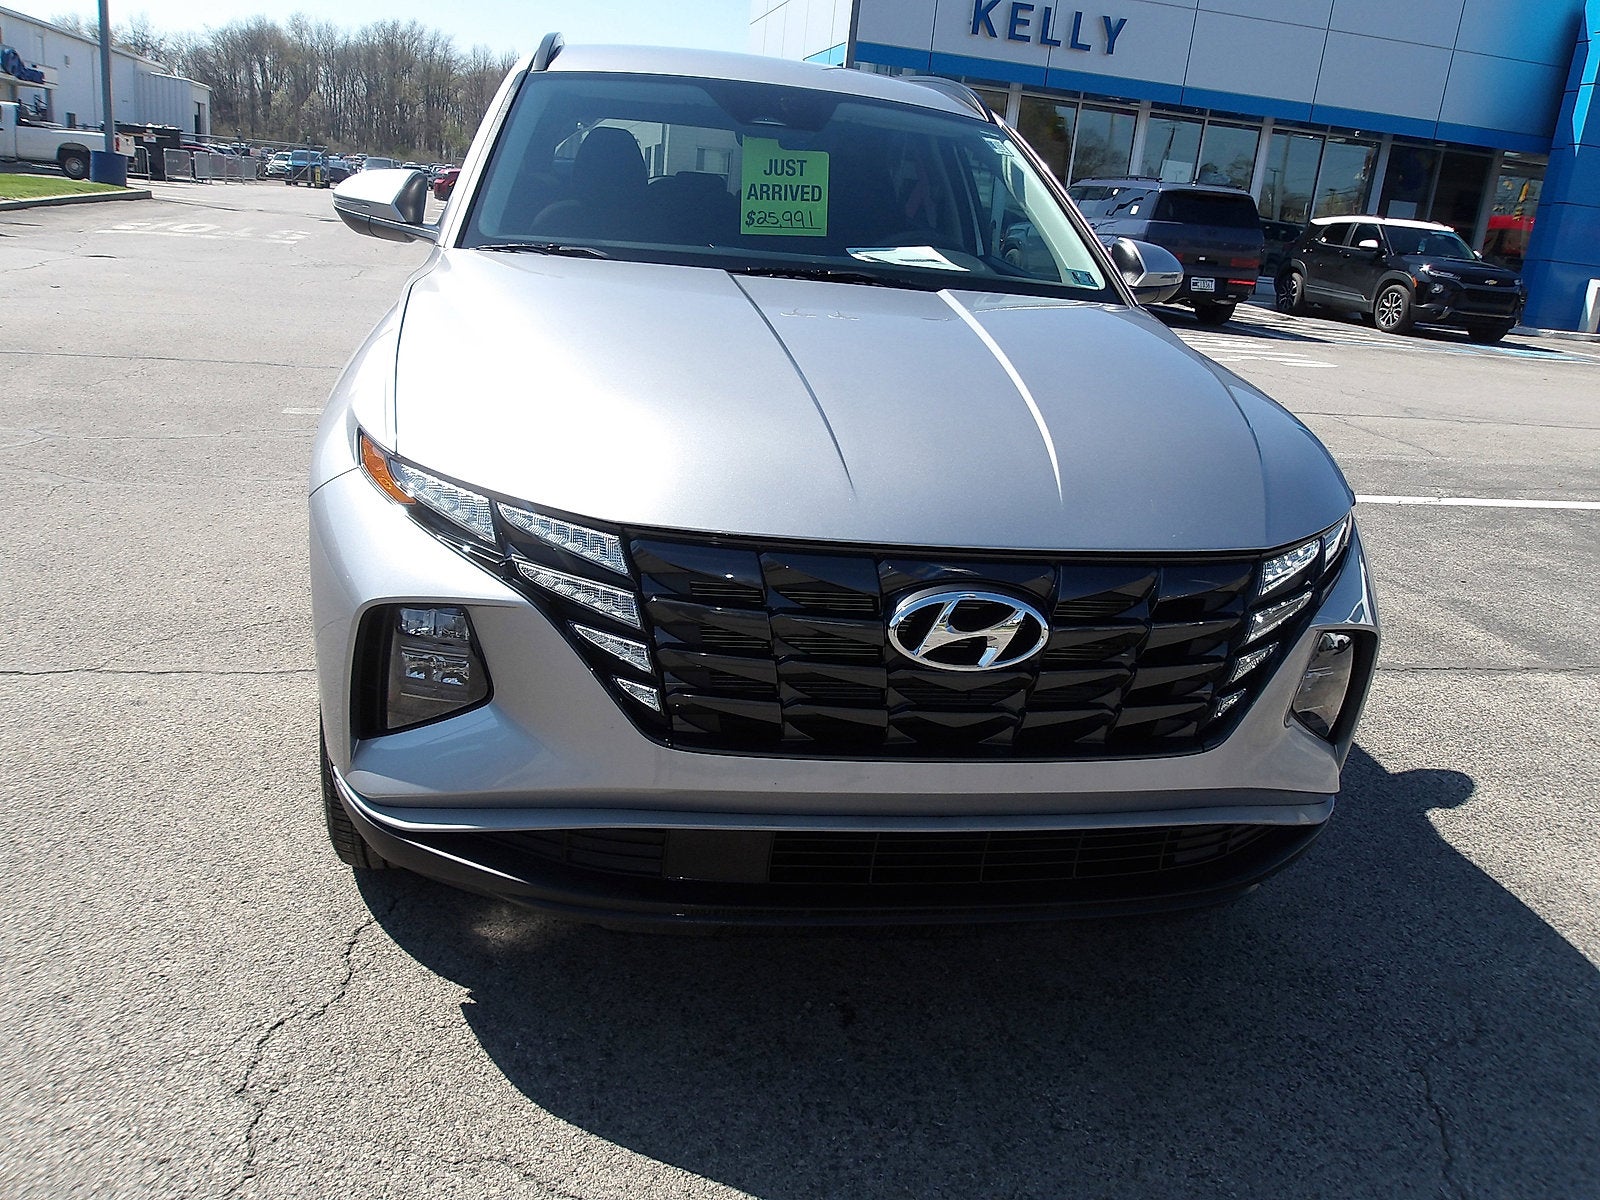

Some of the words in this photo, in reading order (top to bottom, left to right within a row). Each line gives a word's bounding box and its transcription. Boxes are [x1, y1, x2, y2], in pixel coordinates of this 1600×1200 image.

[970, 0, 1128, 56] KELLY
[763, 159, 808, 177] JUST
[746, 184, 823, 202] ARRIVED
[745, 210, 816, 229] $25,991
